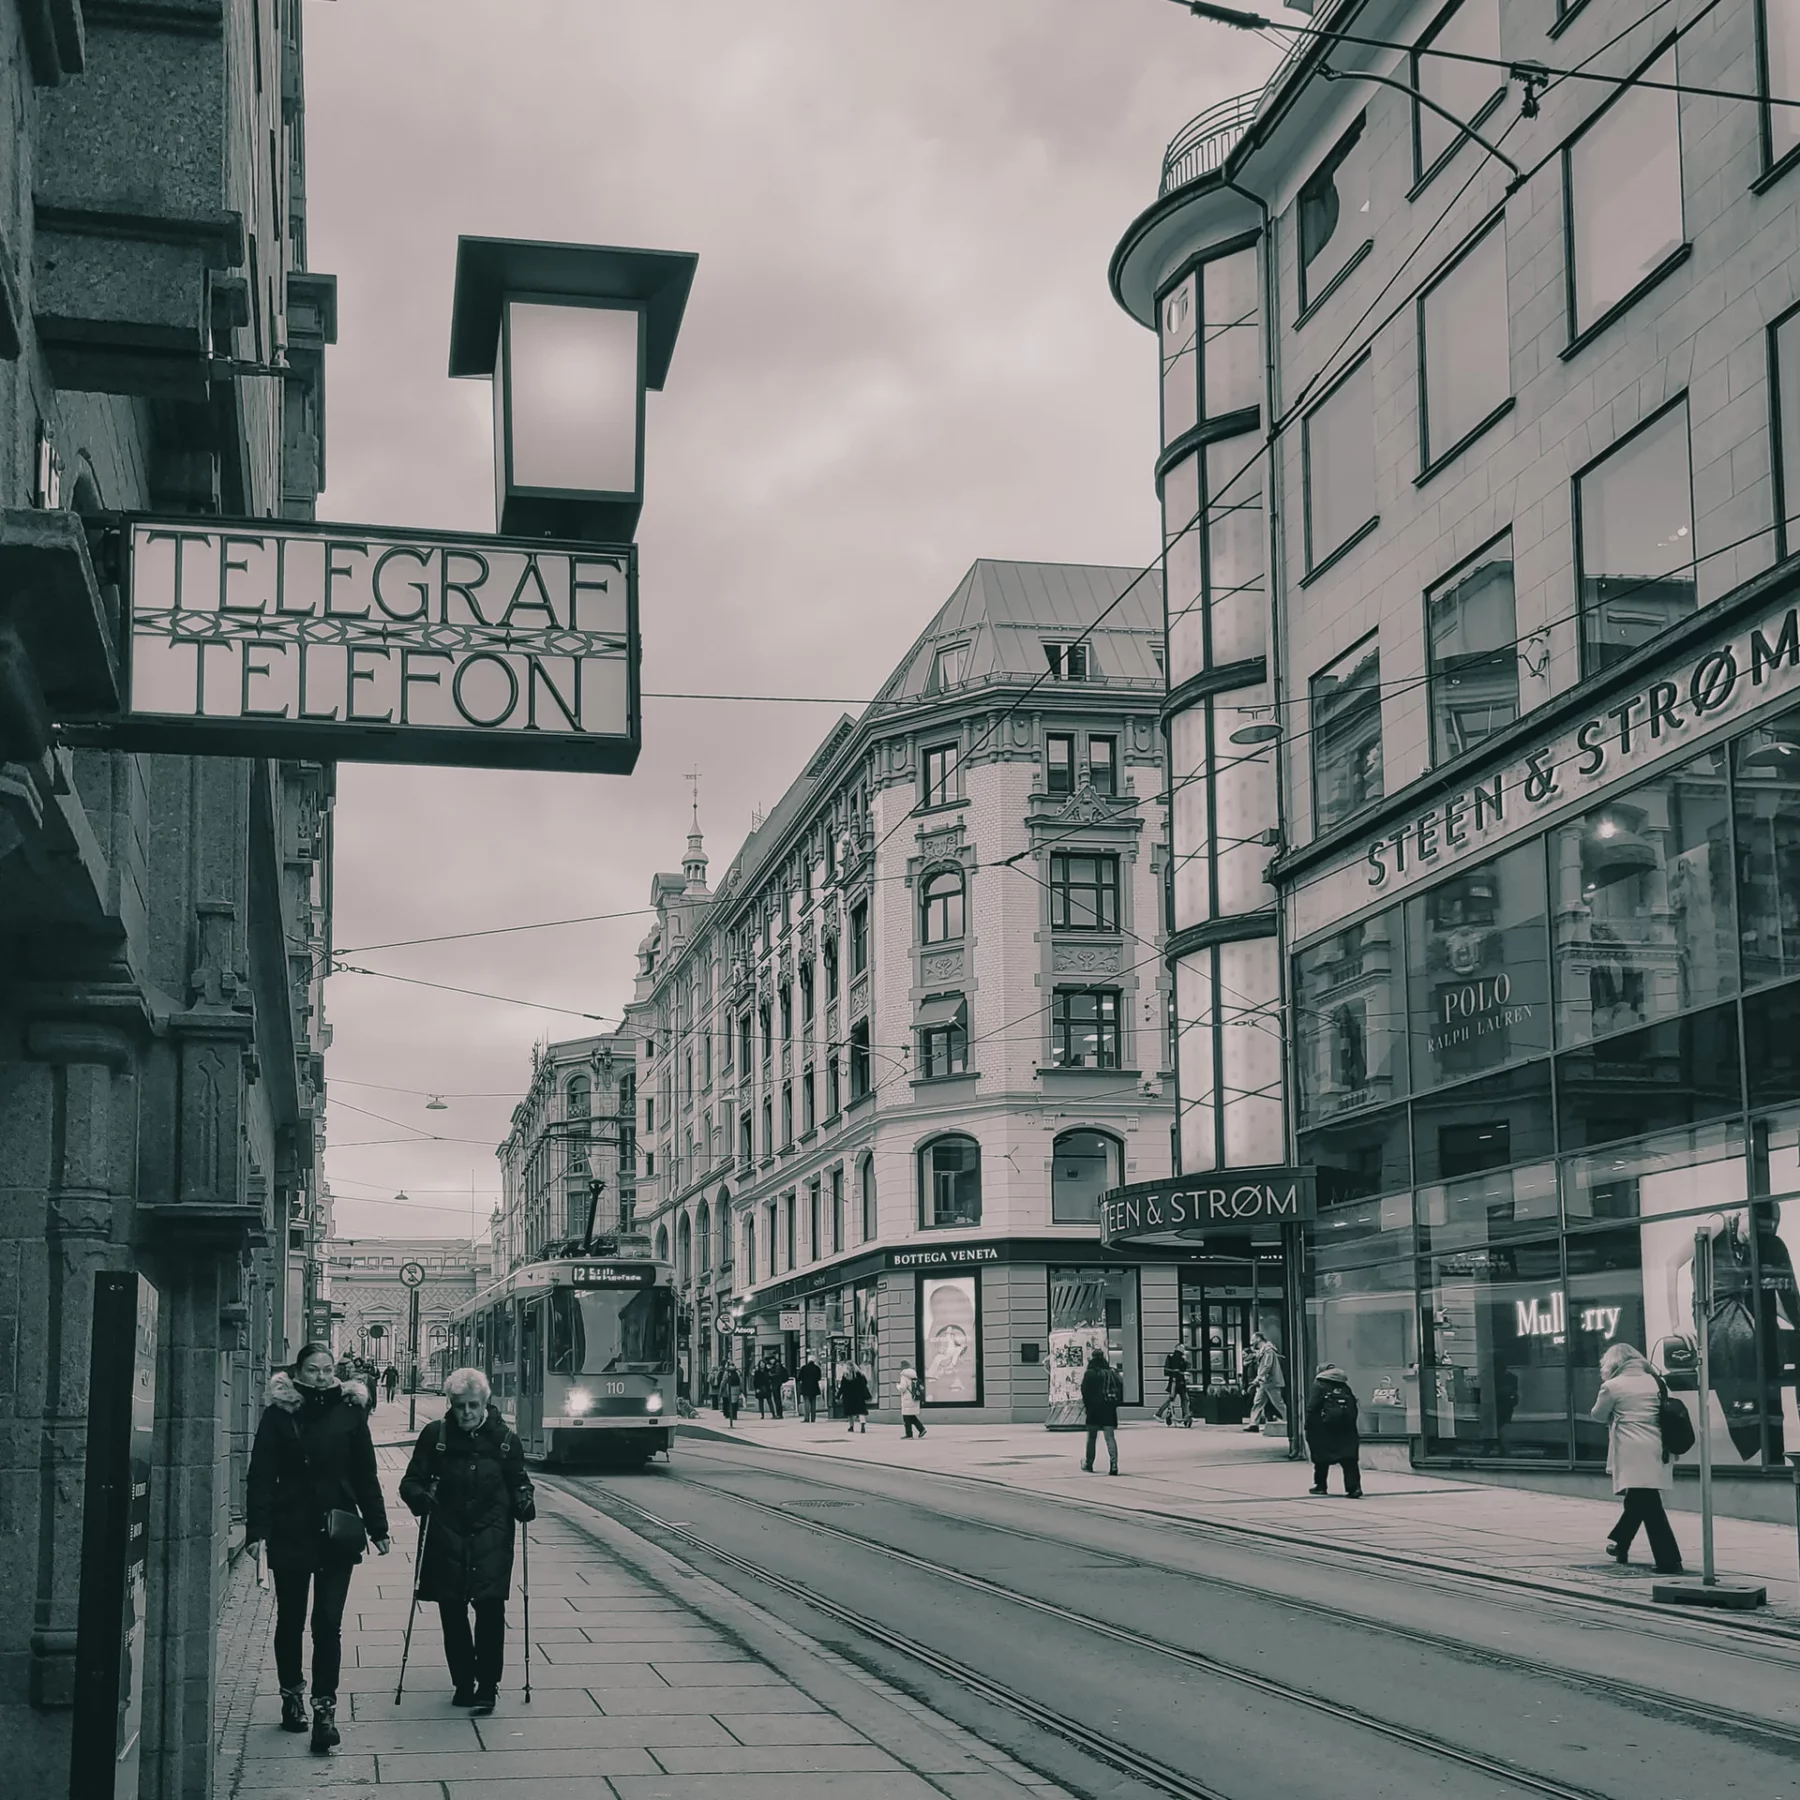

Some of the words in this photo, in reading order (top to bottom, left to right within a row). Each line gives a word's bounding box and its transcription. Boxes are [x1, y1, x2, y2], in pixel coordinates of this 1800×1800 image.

[146, 530, 622, 630] TELEGRAF
[168, 636, 587, 732] TELEFON
[1368, 774, 1504, 886] STEEN
[1524, 748, 1559, 802] &
[1577, 608, 1800, 775] STRØM
[1444, 973, 1511, 1024] POLO
[1427, 1026, 1469, 1053] RALPH
[1477, 1004, 1532, 1035] LAUREN
[1147, 1196, 1163, 1225] &
[1171, 1184, 1297, 1223] STRØM
[574, 1268, 585, 1281] 12
[894, 1252, 947, 1265] BOTTEGA
[951, 1248, 998, 1261] VENETA
[606, 1381, 625, 1395] 110
